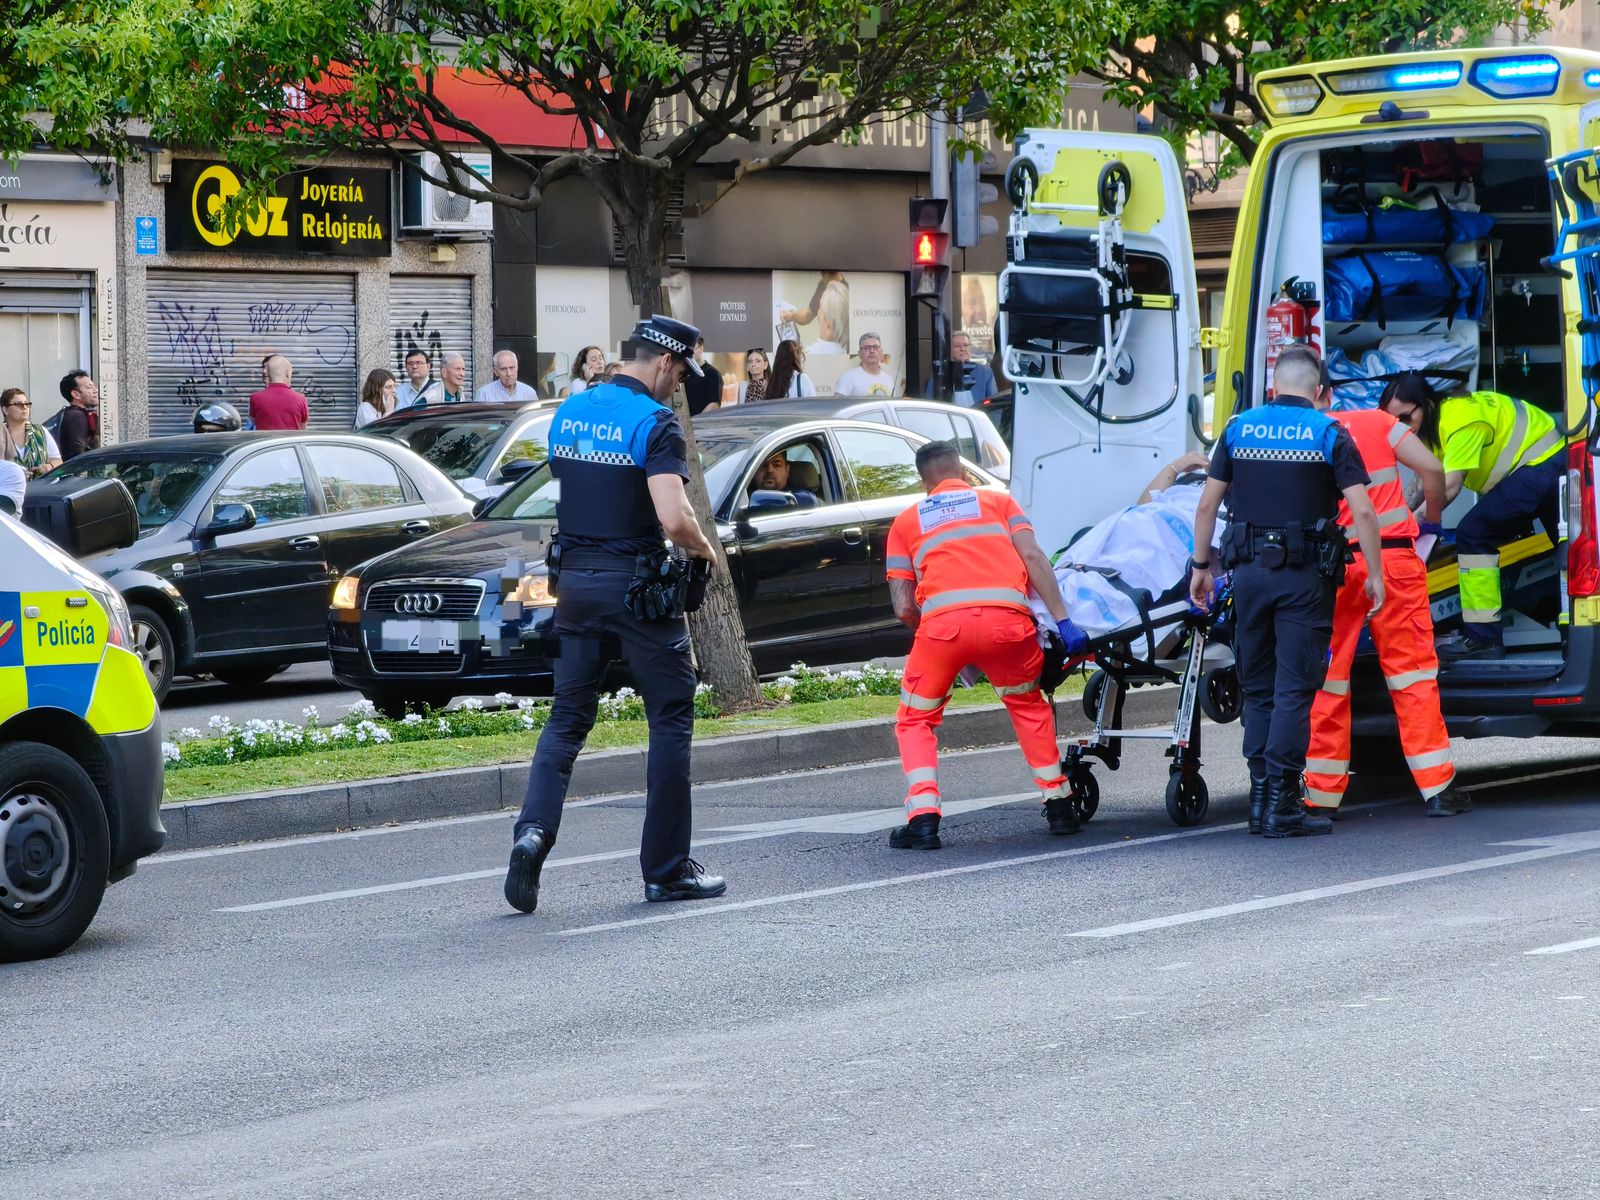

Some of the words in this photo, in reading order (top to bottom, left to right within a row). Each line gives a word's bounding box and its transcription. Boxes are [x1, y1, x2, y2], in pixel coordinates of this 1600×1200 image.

[860, 114, 874, 145] &
[720, 300, 747, 311] PRÓTESIS
[719, 313, 748, 322] DENTALES
[1241, 422, 1315, 441] POLICÍA
[940, 506, 956, 514] 112
[37, 619, 95, 647] Policía
